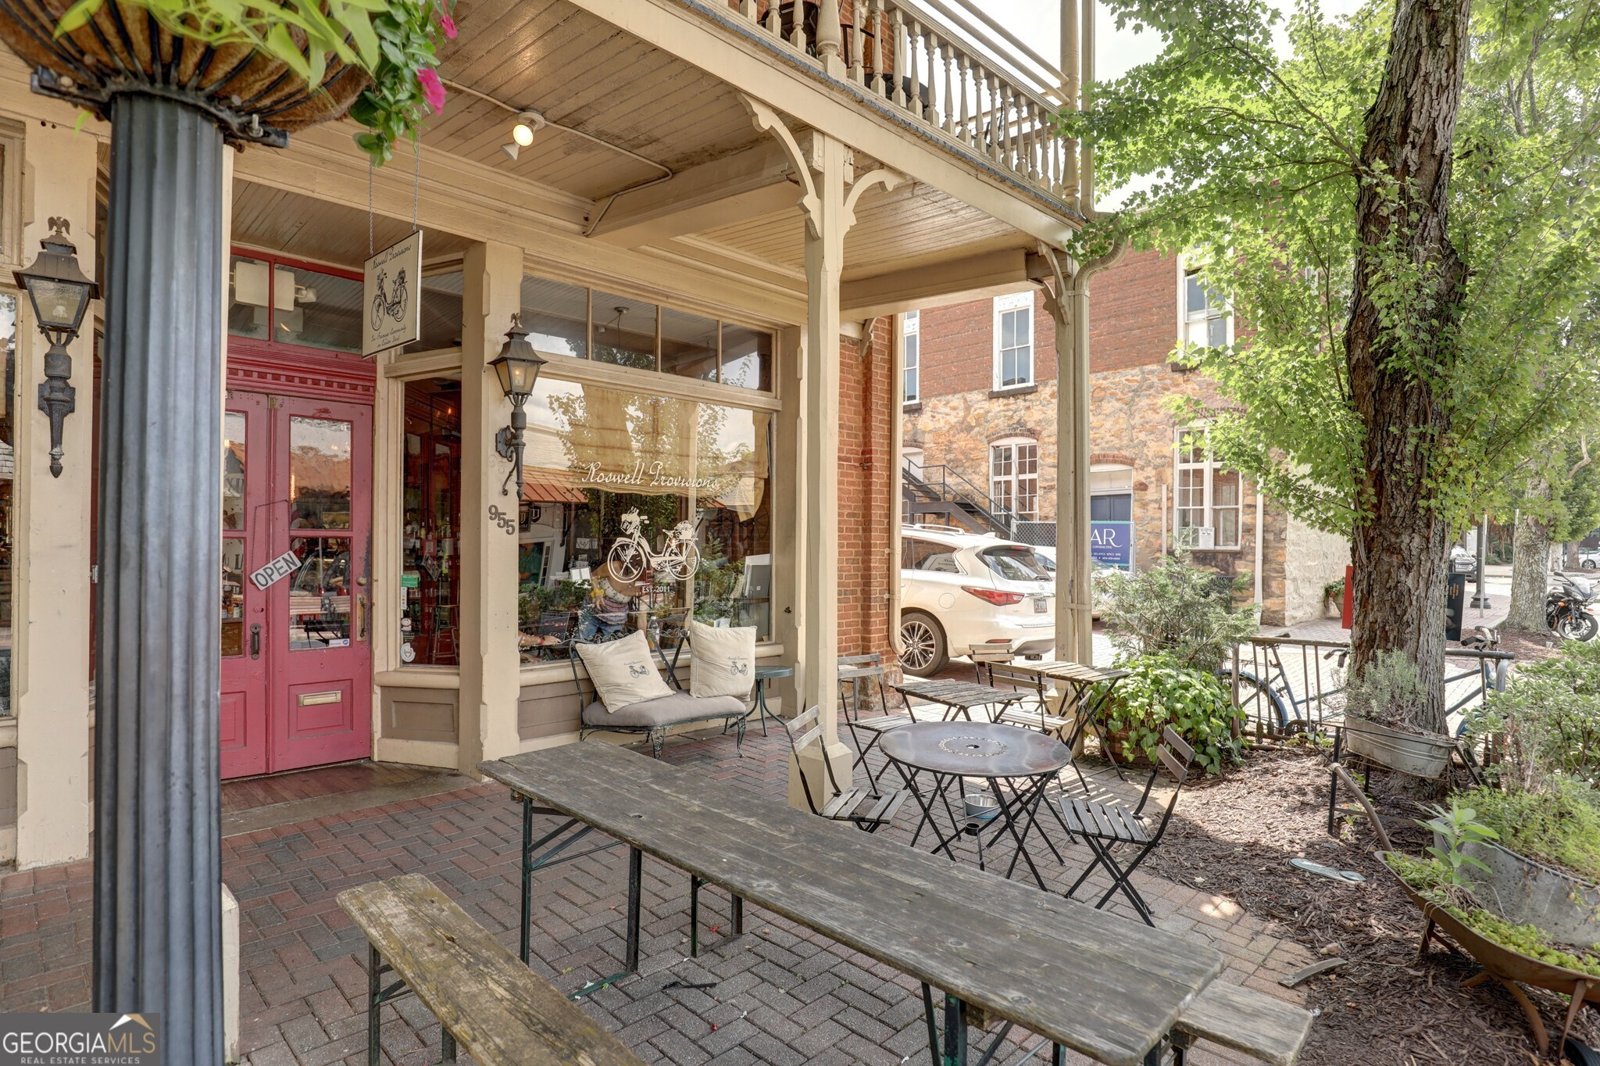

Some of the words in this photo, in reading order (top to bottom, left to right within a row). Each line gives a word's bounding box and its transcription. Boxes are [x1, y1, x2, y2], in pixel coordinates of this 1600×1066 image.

[582, 458, 645, 485] Roswell
[648, 460, 720, 489] Provisions
[488, 504, 516, 536] 955
[254, 552, 298, 587] OPEN
[656, 585, 671, 593] 2011
